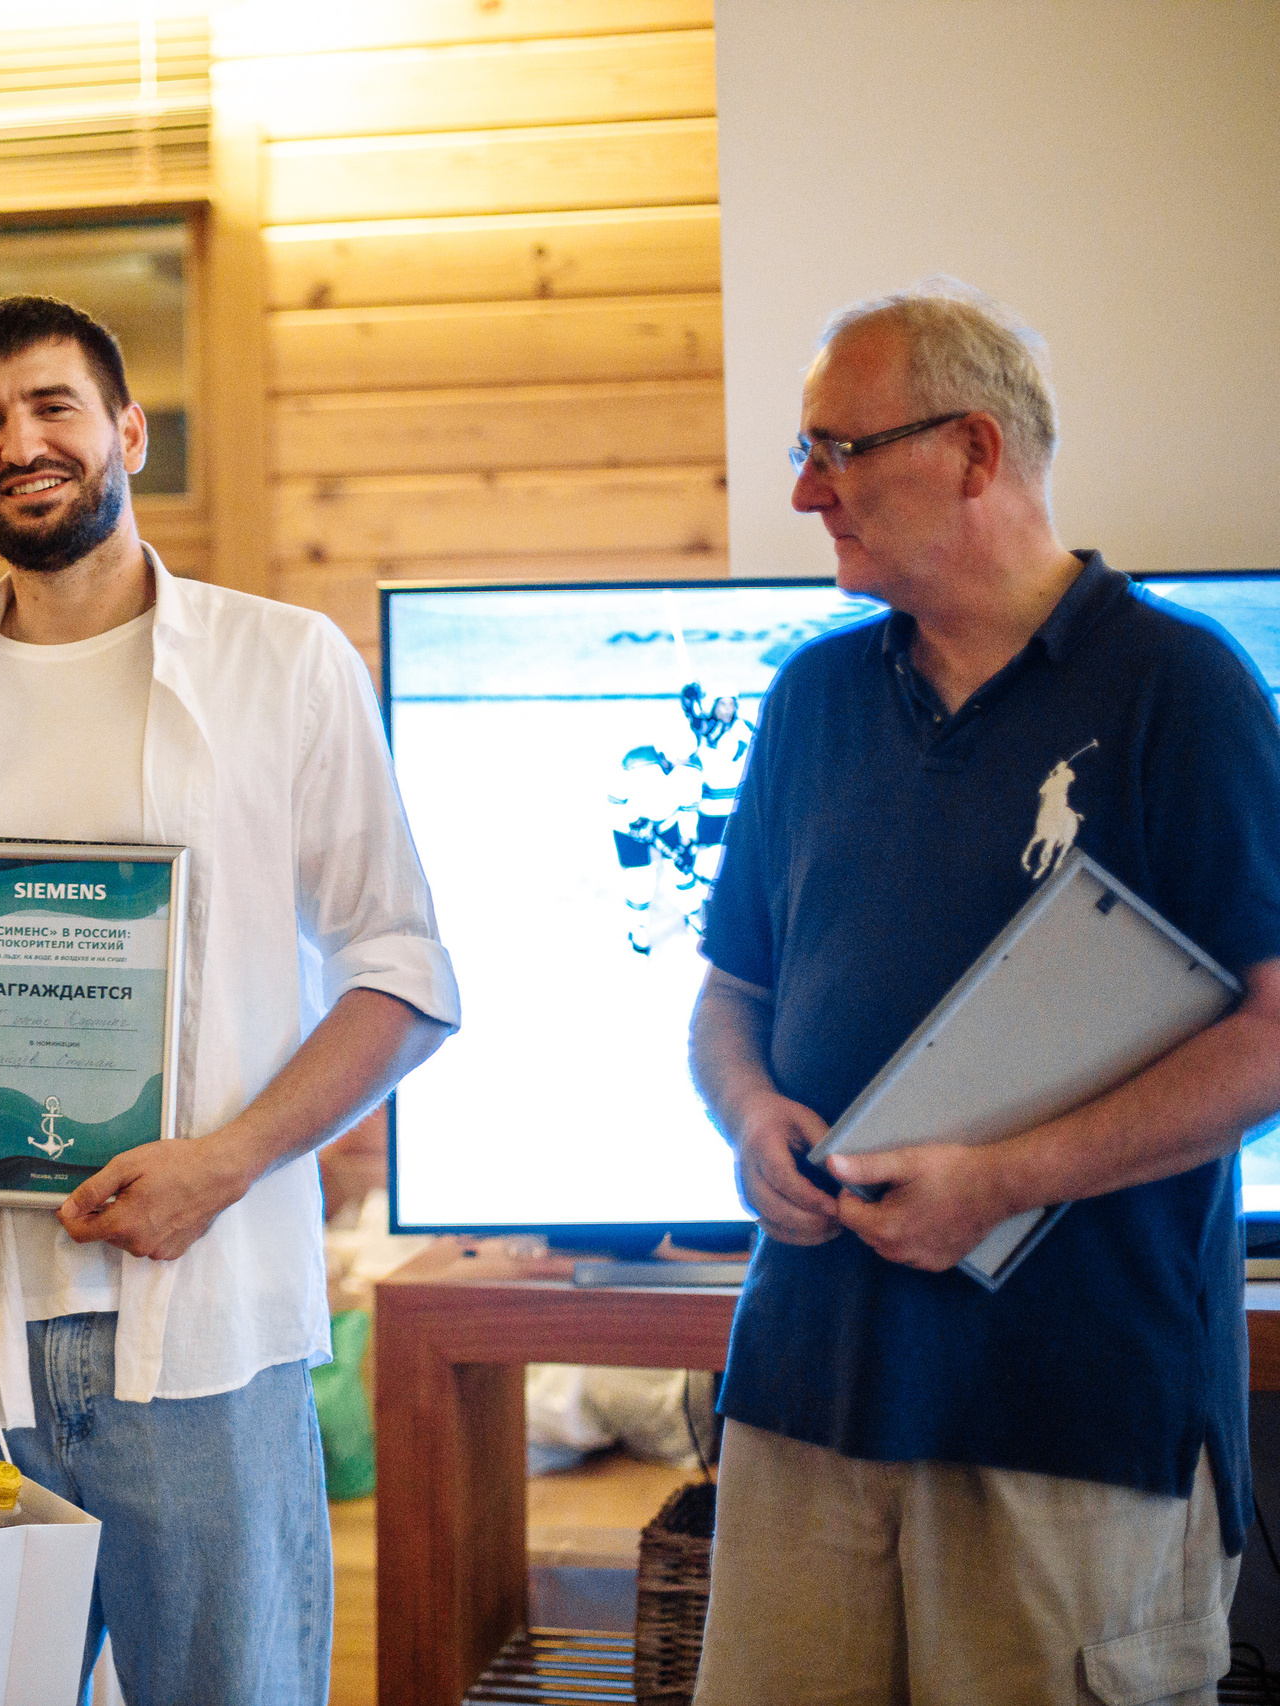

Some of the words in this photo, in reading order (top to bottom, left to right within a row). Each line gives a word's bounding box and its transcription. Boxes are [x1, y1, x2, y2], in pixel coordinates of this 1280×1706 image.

[13, 881, 108, 901] SIEMENS
[61, 927, 71, 938] В
[74, 927, 132, 940] РОССИИ:
[77, 940, 124, 951] СТИХИЙ
[36, 1039, 81, 1048] номинации
